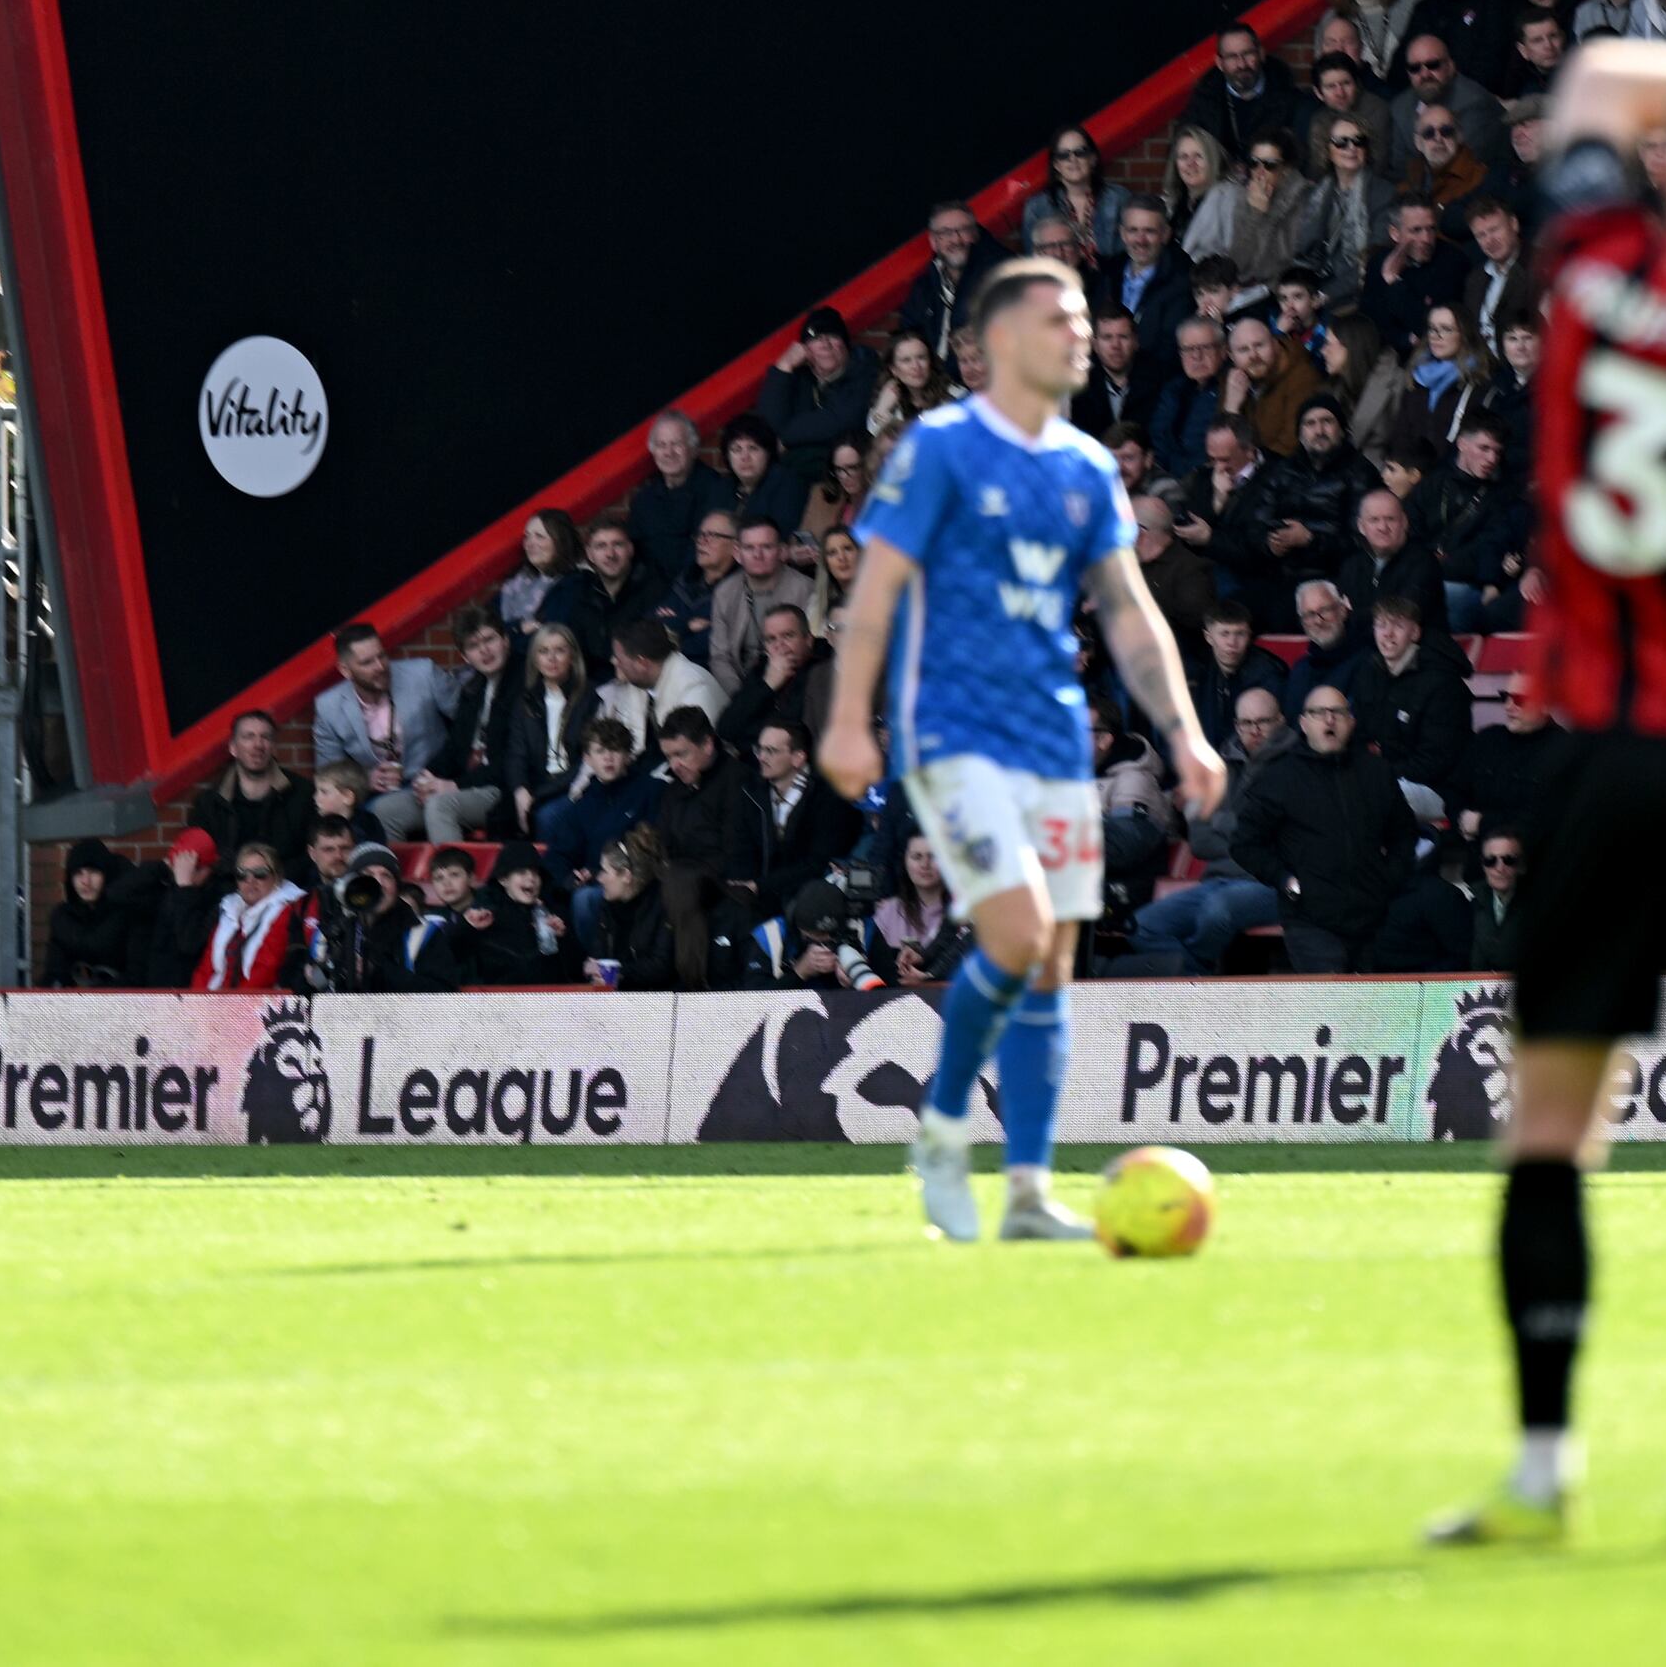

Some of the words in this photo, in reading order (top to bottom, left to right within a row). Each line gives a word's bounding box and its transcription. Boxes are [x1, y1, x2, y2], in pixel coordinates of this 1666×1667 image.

[206, 376, 322, 457] Vitality
[357, 1036, 629, 1143] League
[1120, 1022, 1406, 1125] Premier
